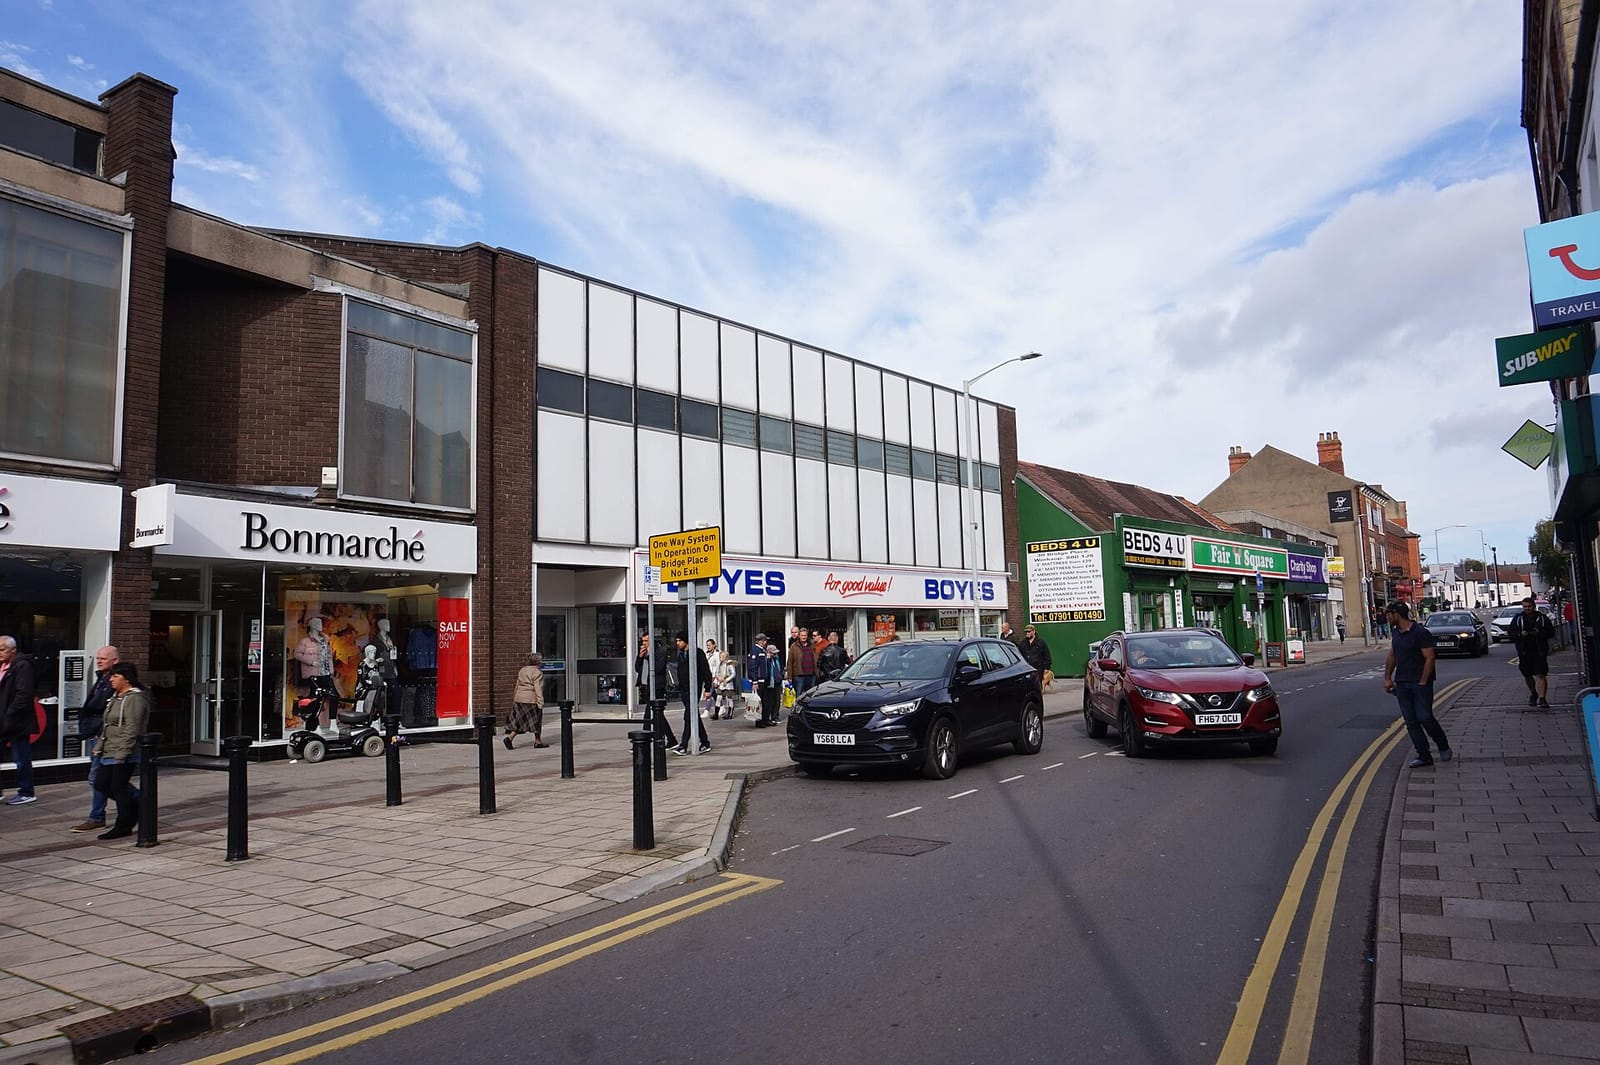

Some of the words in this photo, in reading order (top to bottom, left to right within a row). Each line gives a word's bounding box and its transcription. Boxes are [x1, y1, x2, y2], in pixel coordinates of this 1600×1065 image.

[1550, 301, 1600, 317] TRAVEL
[1503, 332, 1577, 377] SUBWAY
[135, 525, 165, 539] Bonmarché
[240, 512, 425, 562] Bonmarché
[653, 540, 668, 549] One
[670, 537, 686, 547] Way
[688, 534, 716, 545] System
[1031, 542, 1068, 552] BEDS
[1072, 541, 1081, 549] 4
[1085, 539, 1096, 548] U
[1124, 530, 1161, 553] BEDS
[1165, 537, 1174, 555] 4
[1177, 538, 1186, 555] U
[655, 551, 662, 559] In
[664, 547, 701, 559] Operation
[703, 544, 715, 553] On
[1211, 545, 1231, 564] Fair
[1244, 549, 1274, 571] Square
[661, 559, 686, 569] Bridge
[688, 555, 709, 565] Place
[1290, 559, 1306, 575] Charity
[1306, 561, 1318, 576] Shop
[671, 569, 682, 578] No
[684, 567, 699, 577] Exit
[824, 573, 842, 591] for
[839, 576, 867, 595] good
[1033, 613, 1048, 622] Tel:
[1049, 611, 1071, 621] 07901
[1073, 610, 1102, 620] 601490
[439, 621, 467, 632] SALE
[439, 632, 456, 641] NOW
[439, 641, 450, 649] ON
[1199, 715, 1220, 723] FH67
[816, 734, 836, 744] YS68
[837, 735, 852, 744] LCA
